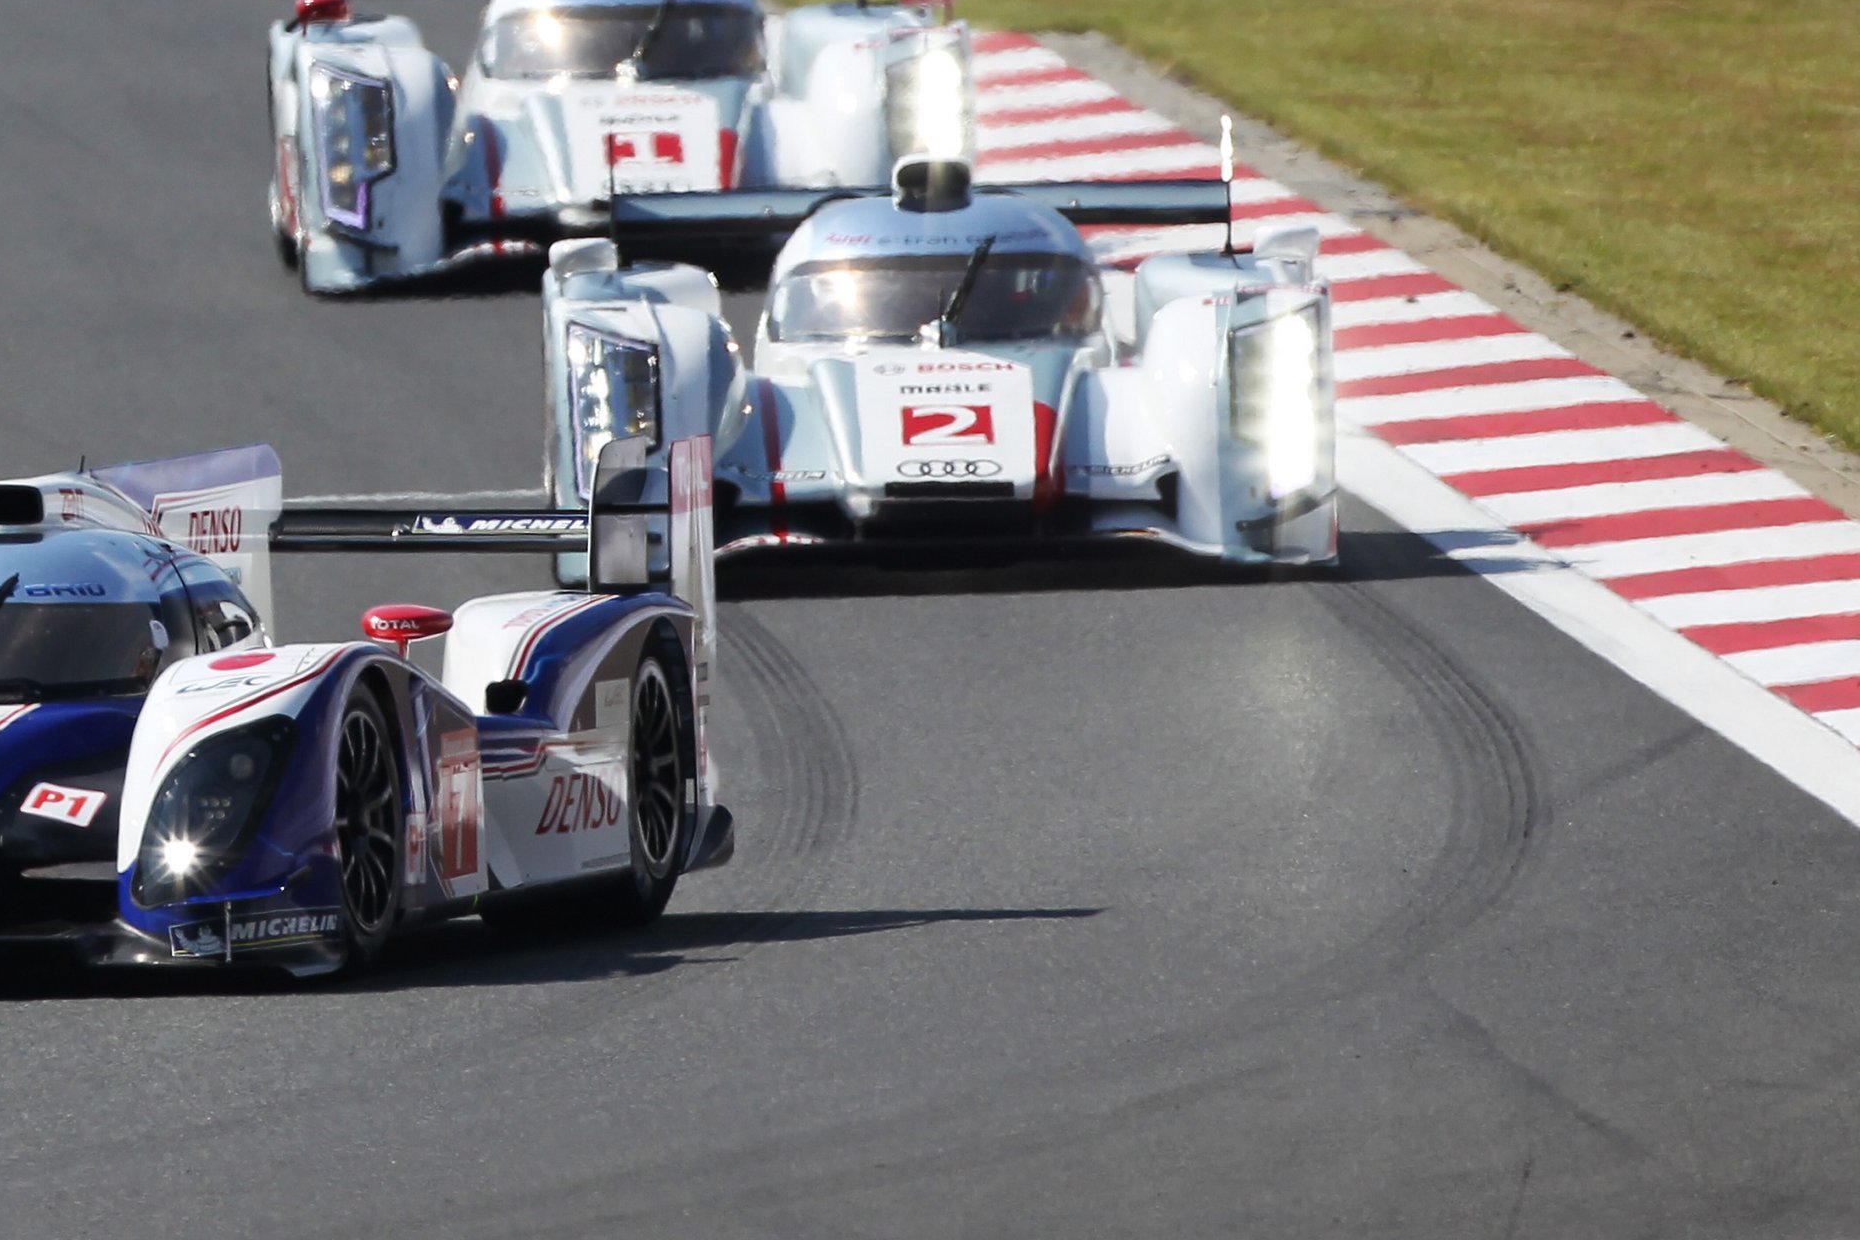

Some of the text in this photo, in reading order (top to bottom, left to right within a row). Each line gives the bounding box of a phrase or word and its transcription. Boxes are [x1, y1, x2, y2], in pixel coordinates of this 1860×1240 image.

[614, 132, 676, 164] 1
[917, 362, 1015, 374] BOSCH
[909, 404, 988, 445] 2
[188, 505, 242, 556] DENSO
[468, 518, 590, 531] MICHEL
[369, 615, 420, 631] TOTAL
[31, 788, 88, 818] P1
[535, 766, 623, 835] DENSO
[231, 913, 338, 940] MICHELIN
